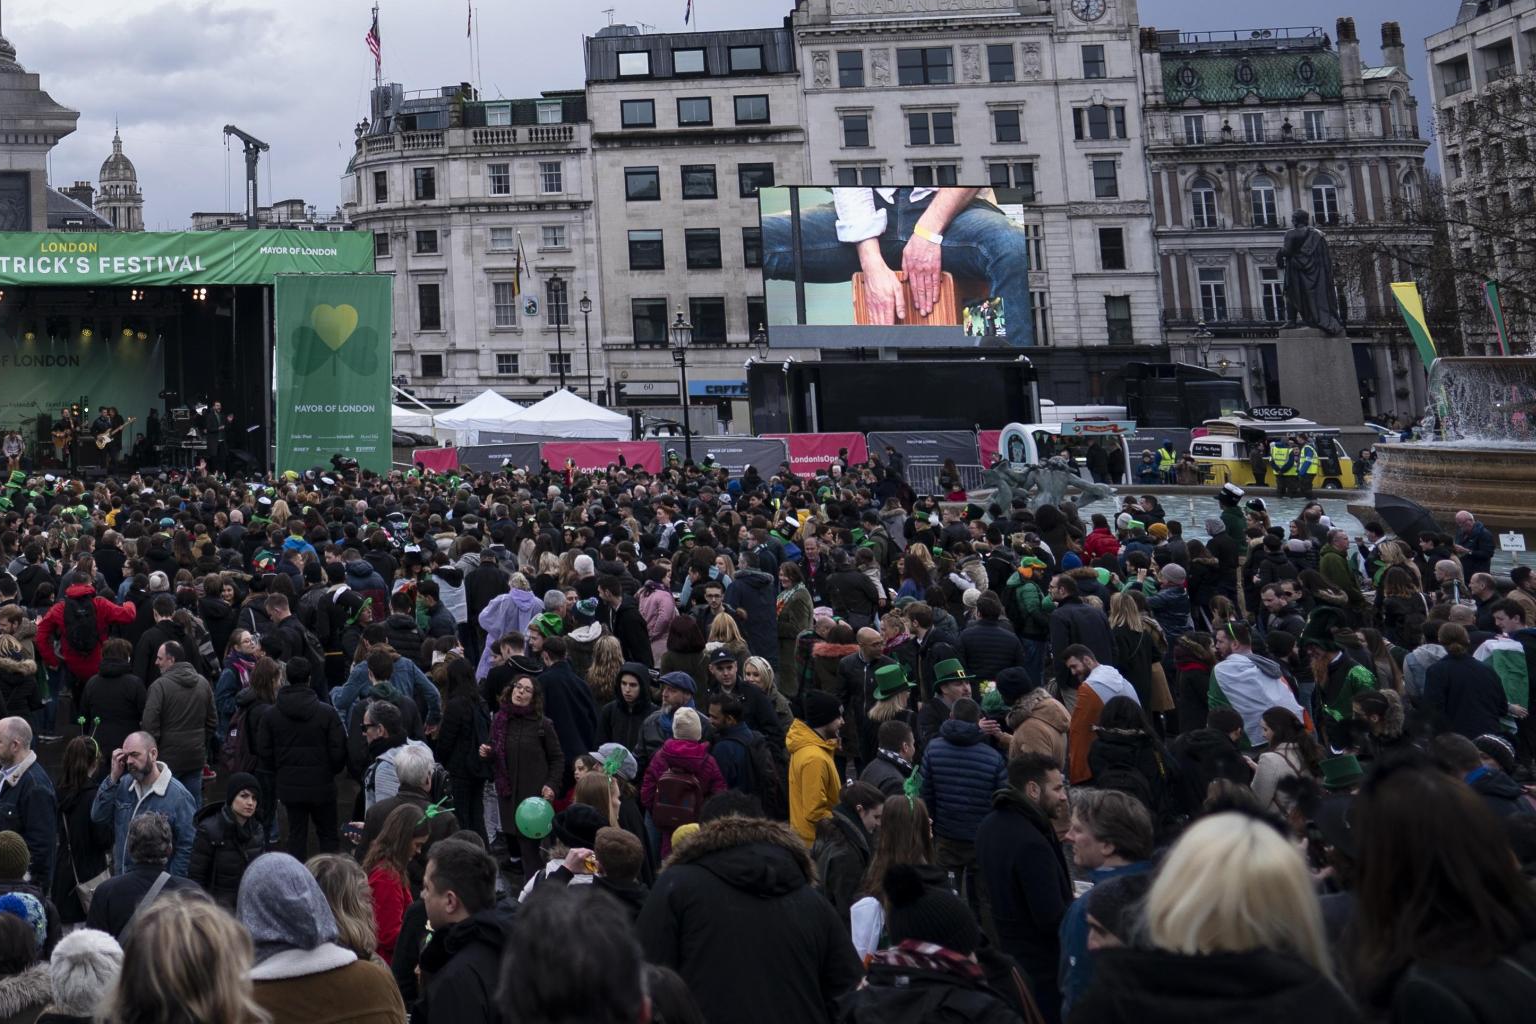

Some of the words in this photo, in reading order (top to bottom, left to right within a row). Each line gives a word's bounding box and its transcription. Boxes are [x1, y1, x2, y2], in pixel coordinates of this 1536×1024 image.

[40, 242, 98, 253] LONDON
[260, 246, 288, 255] MAYOR
[289, 247, 301, 255] OF
[302, 247, 337, 256] LONDON
[99, 256, 207, 274] FESTIVAL
[15, 355, 80, 367] LONDON
[643, 383, 654, 391] 60
[294, 405, 323, 413] MAYOR
[325, 405, 337, 413] OF
[338, 405, 375, 413] LONDON
[1252, 407, 1293, 417] BURGERS
[790, 455, 839, 464] LondonIsOpe
